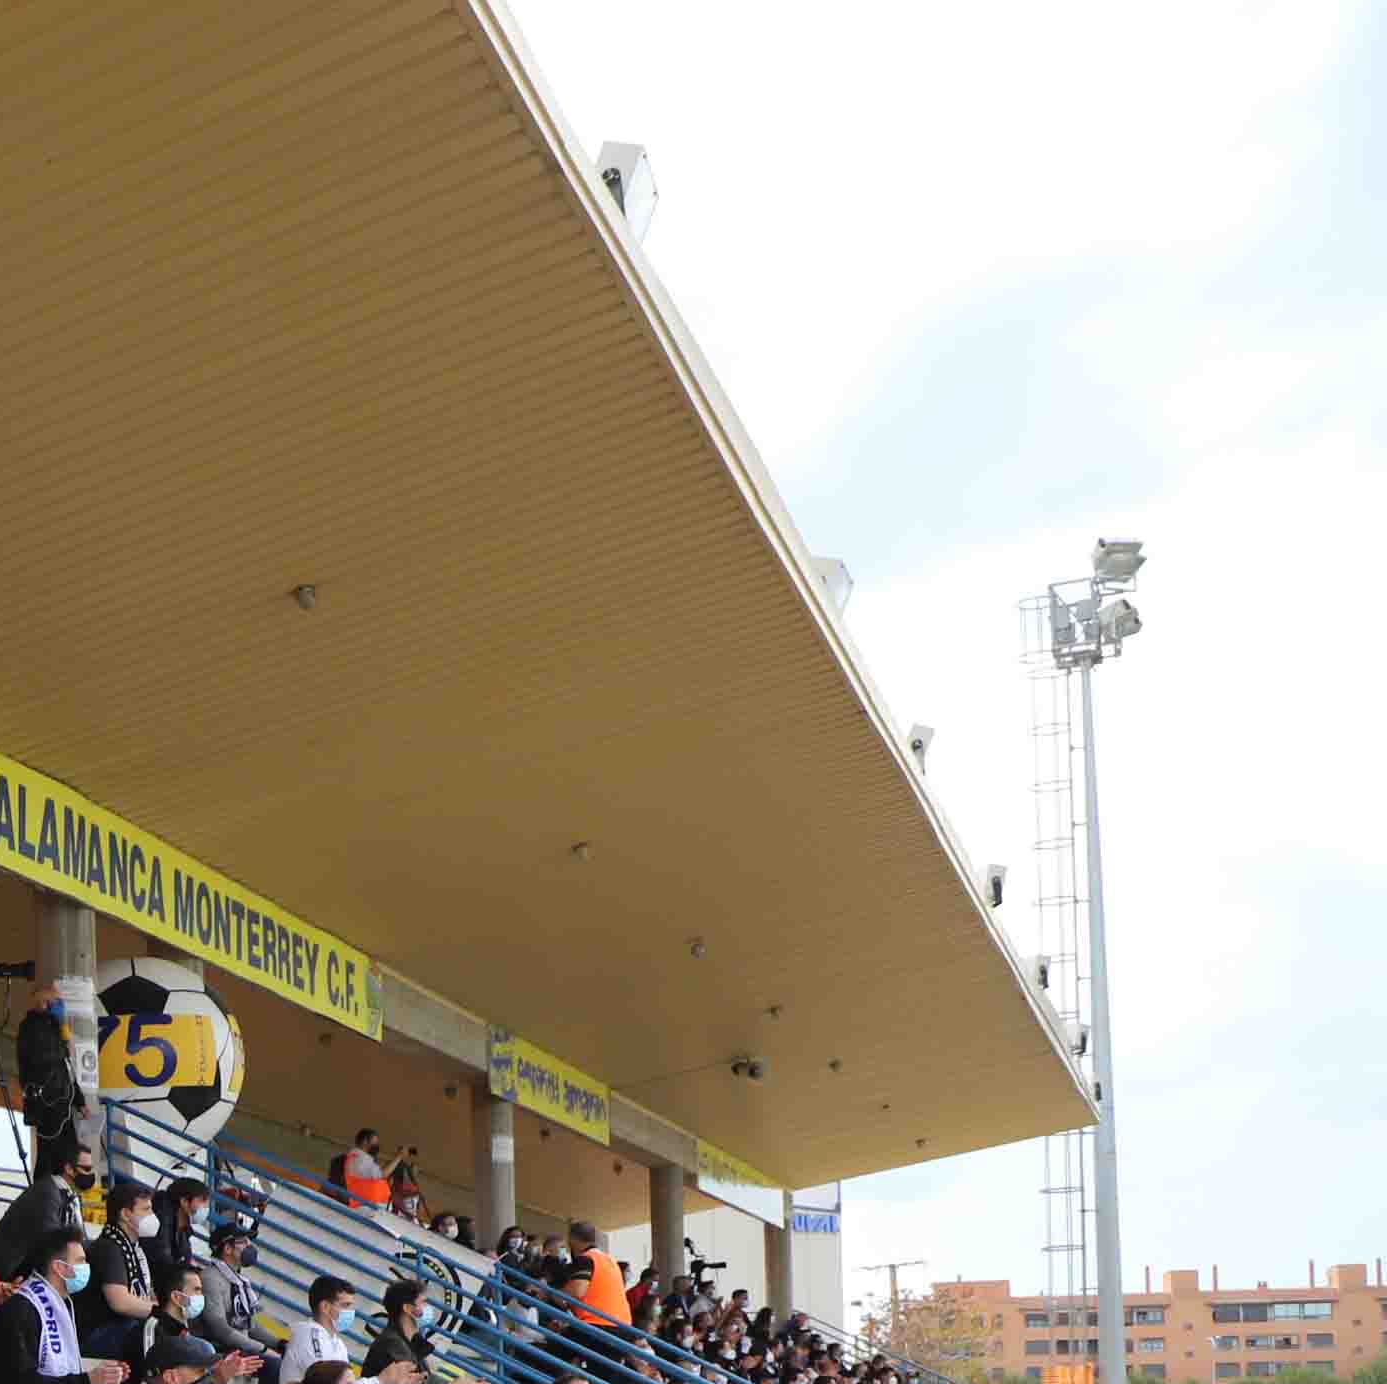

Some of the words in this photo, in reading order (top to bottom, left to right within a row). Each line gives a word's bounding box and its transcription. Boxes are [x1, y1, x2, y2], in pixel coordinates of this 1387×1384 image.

[173, 868, 320, 997] MONTERREY
[326, 949, 360, 1016] C.F.
[28, 1280, 62, 1355] MADRID
